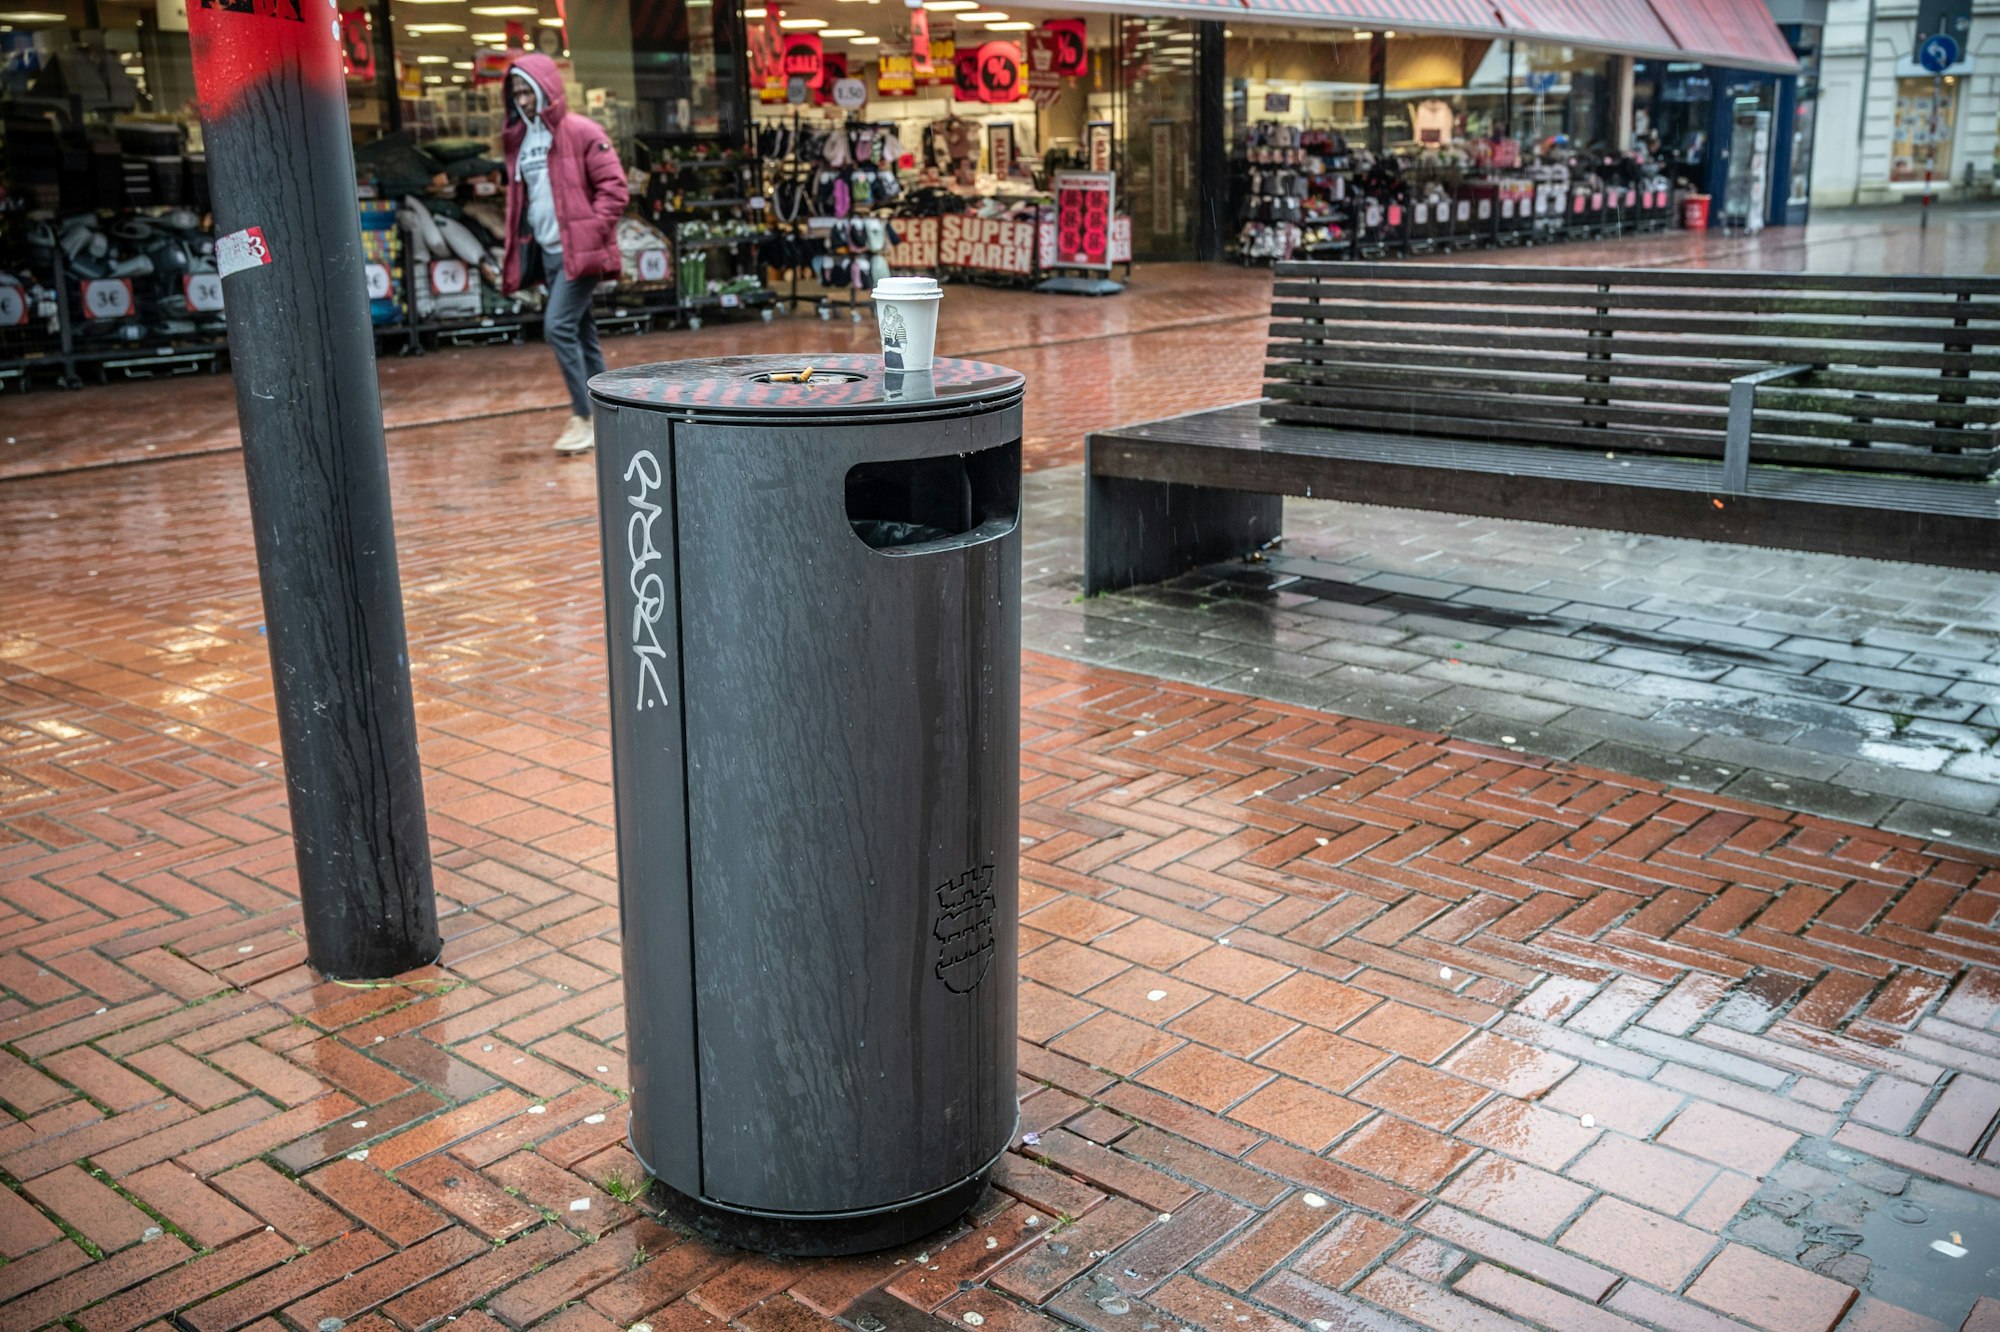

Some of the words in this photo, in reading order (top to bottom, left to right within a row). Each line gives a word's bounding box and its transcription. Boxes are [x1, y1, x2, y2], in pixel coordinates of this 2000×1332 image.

[786, 56, 821, 73] SALE
[890, 218, 938, 242] PER
[941, 214, 1035, 248] SUPER
[939, 239, 1033, 274] SPAREN
[96, 290, 121, 308] 3€
